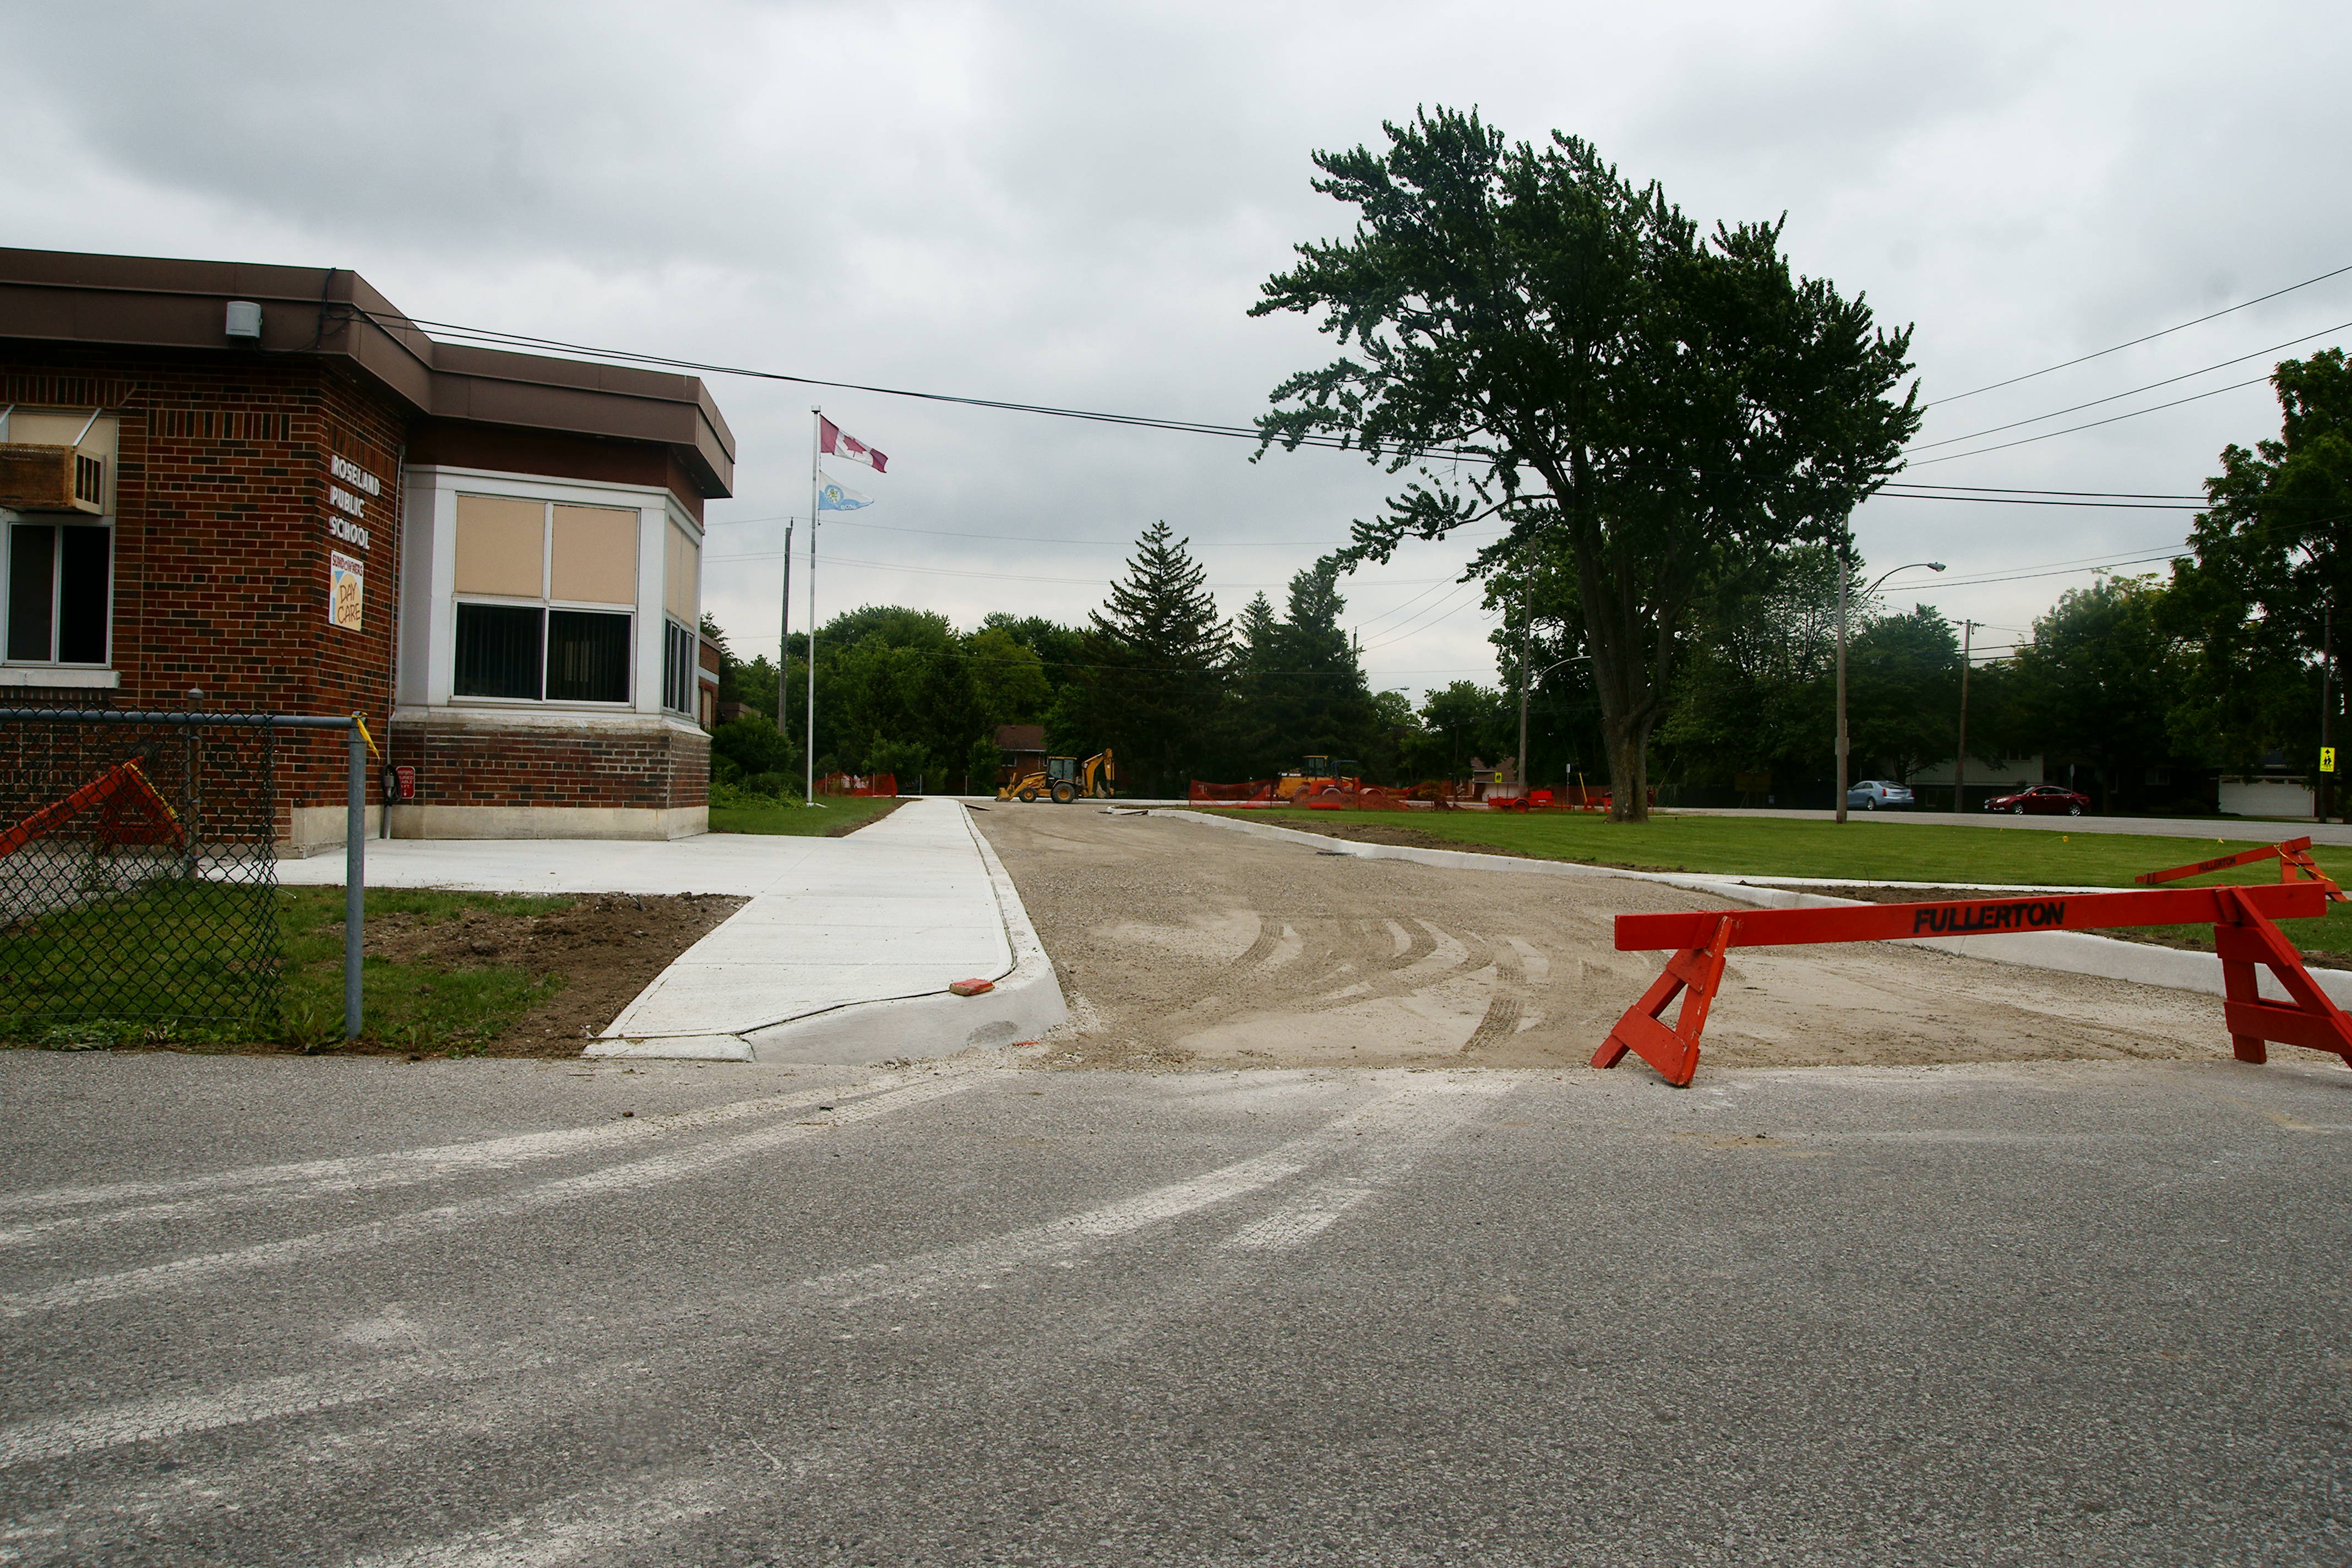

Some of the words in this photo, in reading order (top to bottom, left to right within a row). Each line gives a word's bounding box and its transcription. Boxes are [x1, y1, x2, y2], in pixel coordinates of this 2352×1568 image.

[331, 455, 380, 496] ROSELAND
[329, 486, 364, 518] PUBLIC
[329, 516, 370, 549] SCHOOL
[340, 582, 357, 603] DAY
[337, 603, 361, 623] CARE
[1913, 901, 2066, 934] FULLERTON
